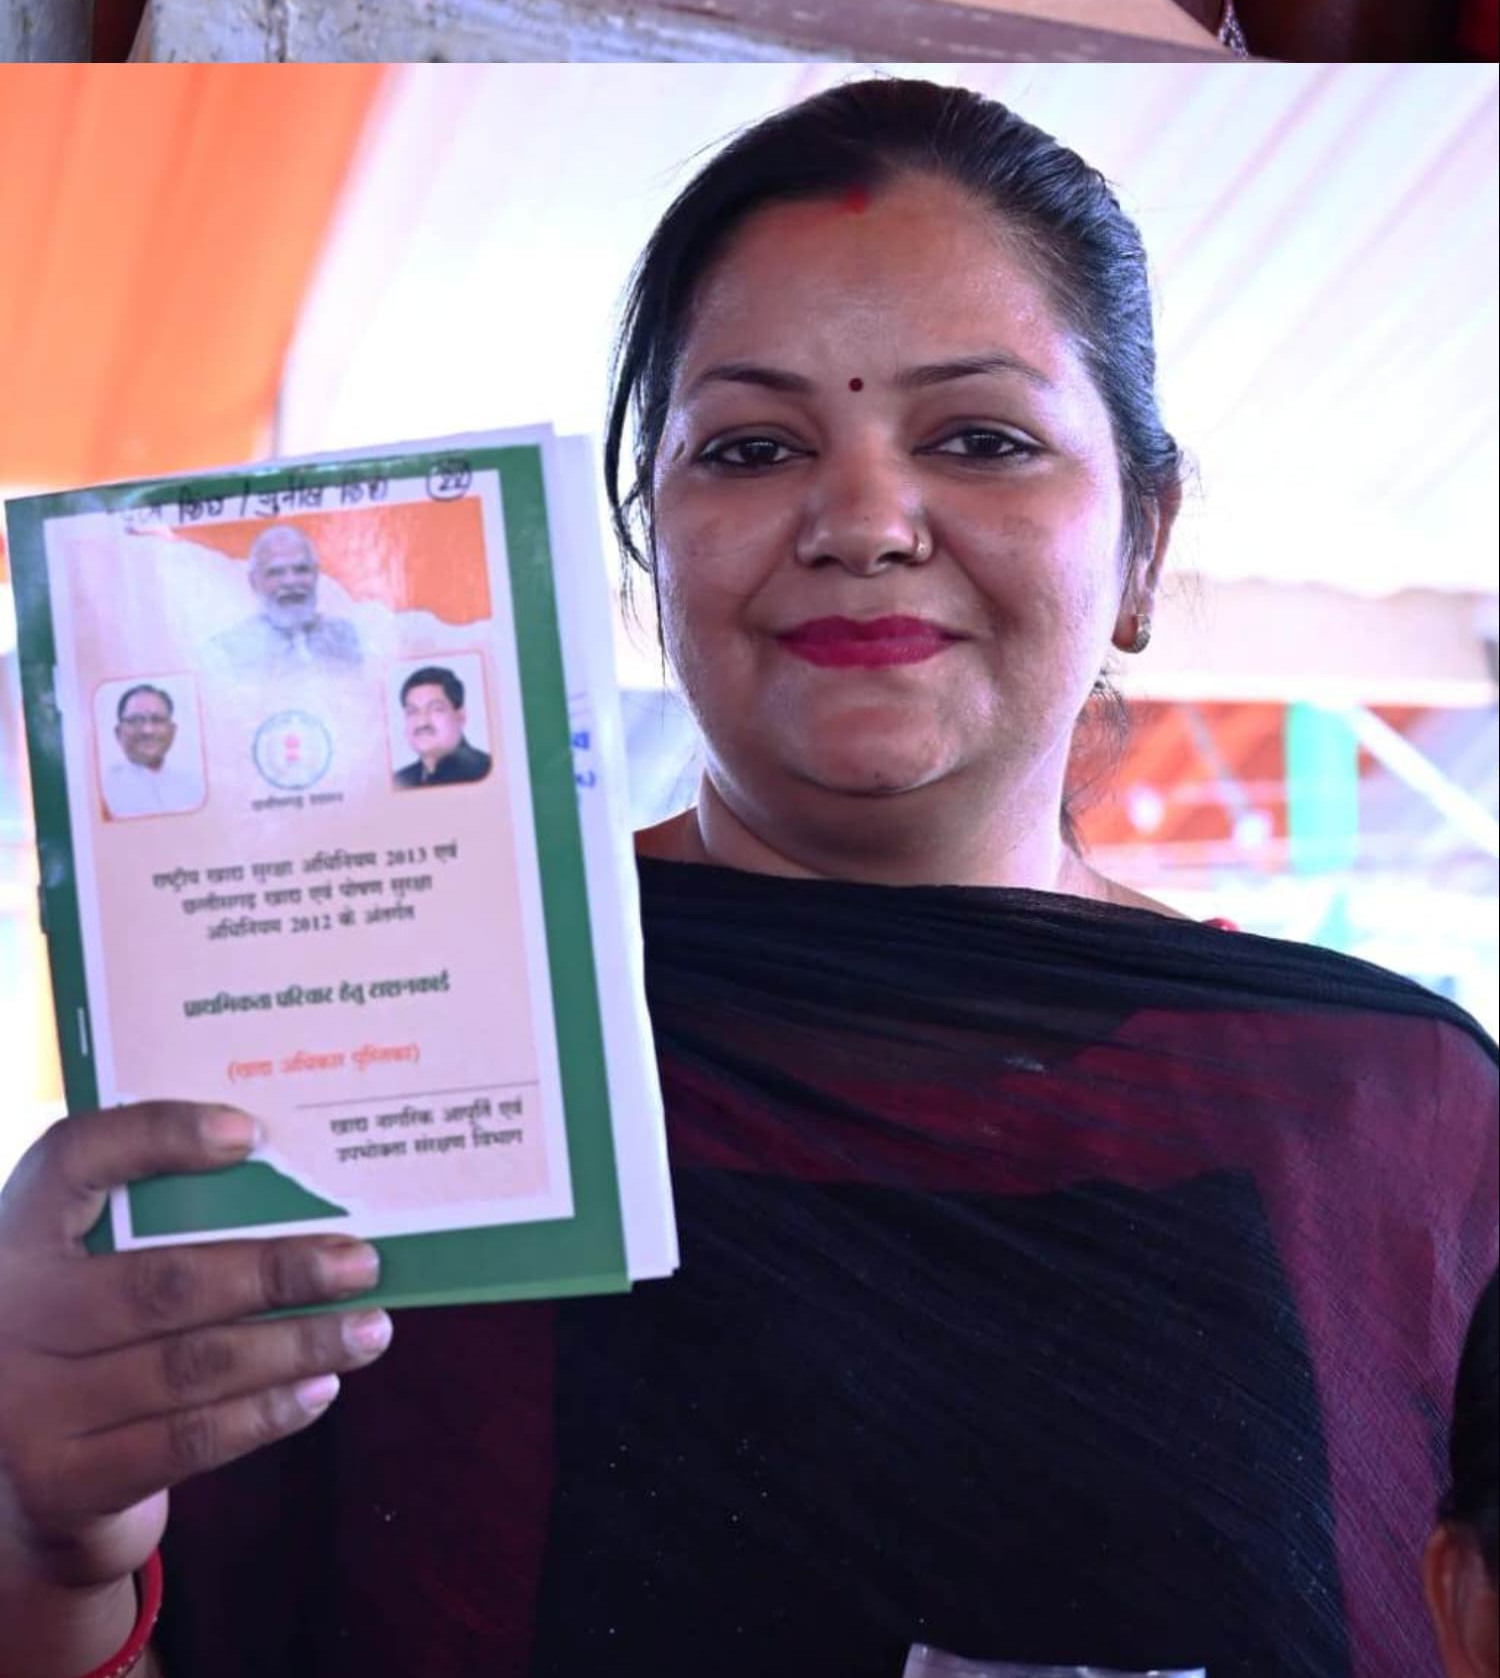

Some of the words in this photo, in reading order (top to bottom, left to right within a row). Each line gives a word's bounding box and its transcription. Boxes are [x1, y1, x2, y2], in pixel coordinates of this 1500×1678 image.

[386, 847, 427, 866] 2013
[433, 841, 458, 863] एवं
[308, 881, 333, 904] एवं
[339, 877, 383, 897] पोषण
[291, 914, 332, 933] 2012
[338, 909, 355, 926] के
[275, 984, 333, 1008] परिवार
[339, 980, 365, 1005] हेतु
[375, 1105, 433, 1128] नागरिक
[498, 1097, 522, 1120] एवं
[470, 1124, 523, 1148] विभाग
